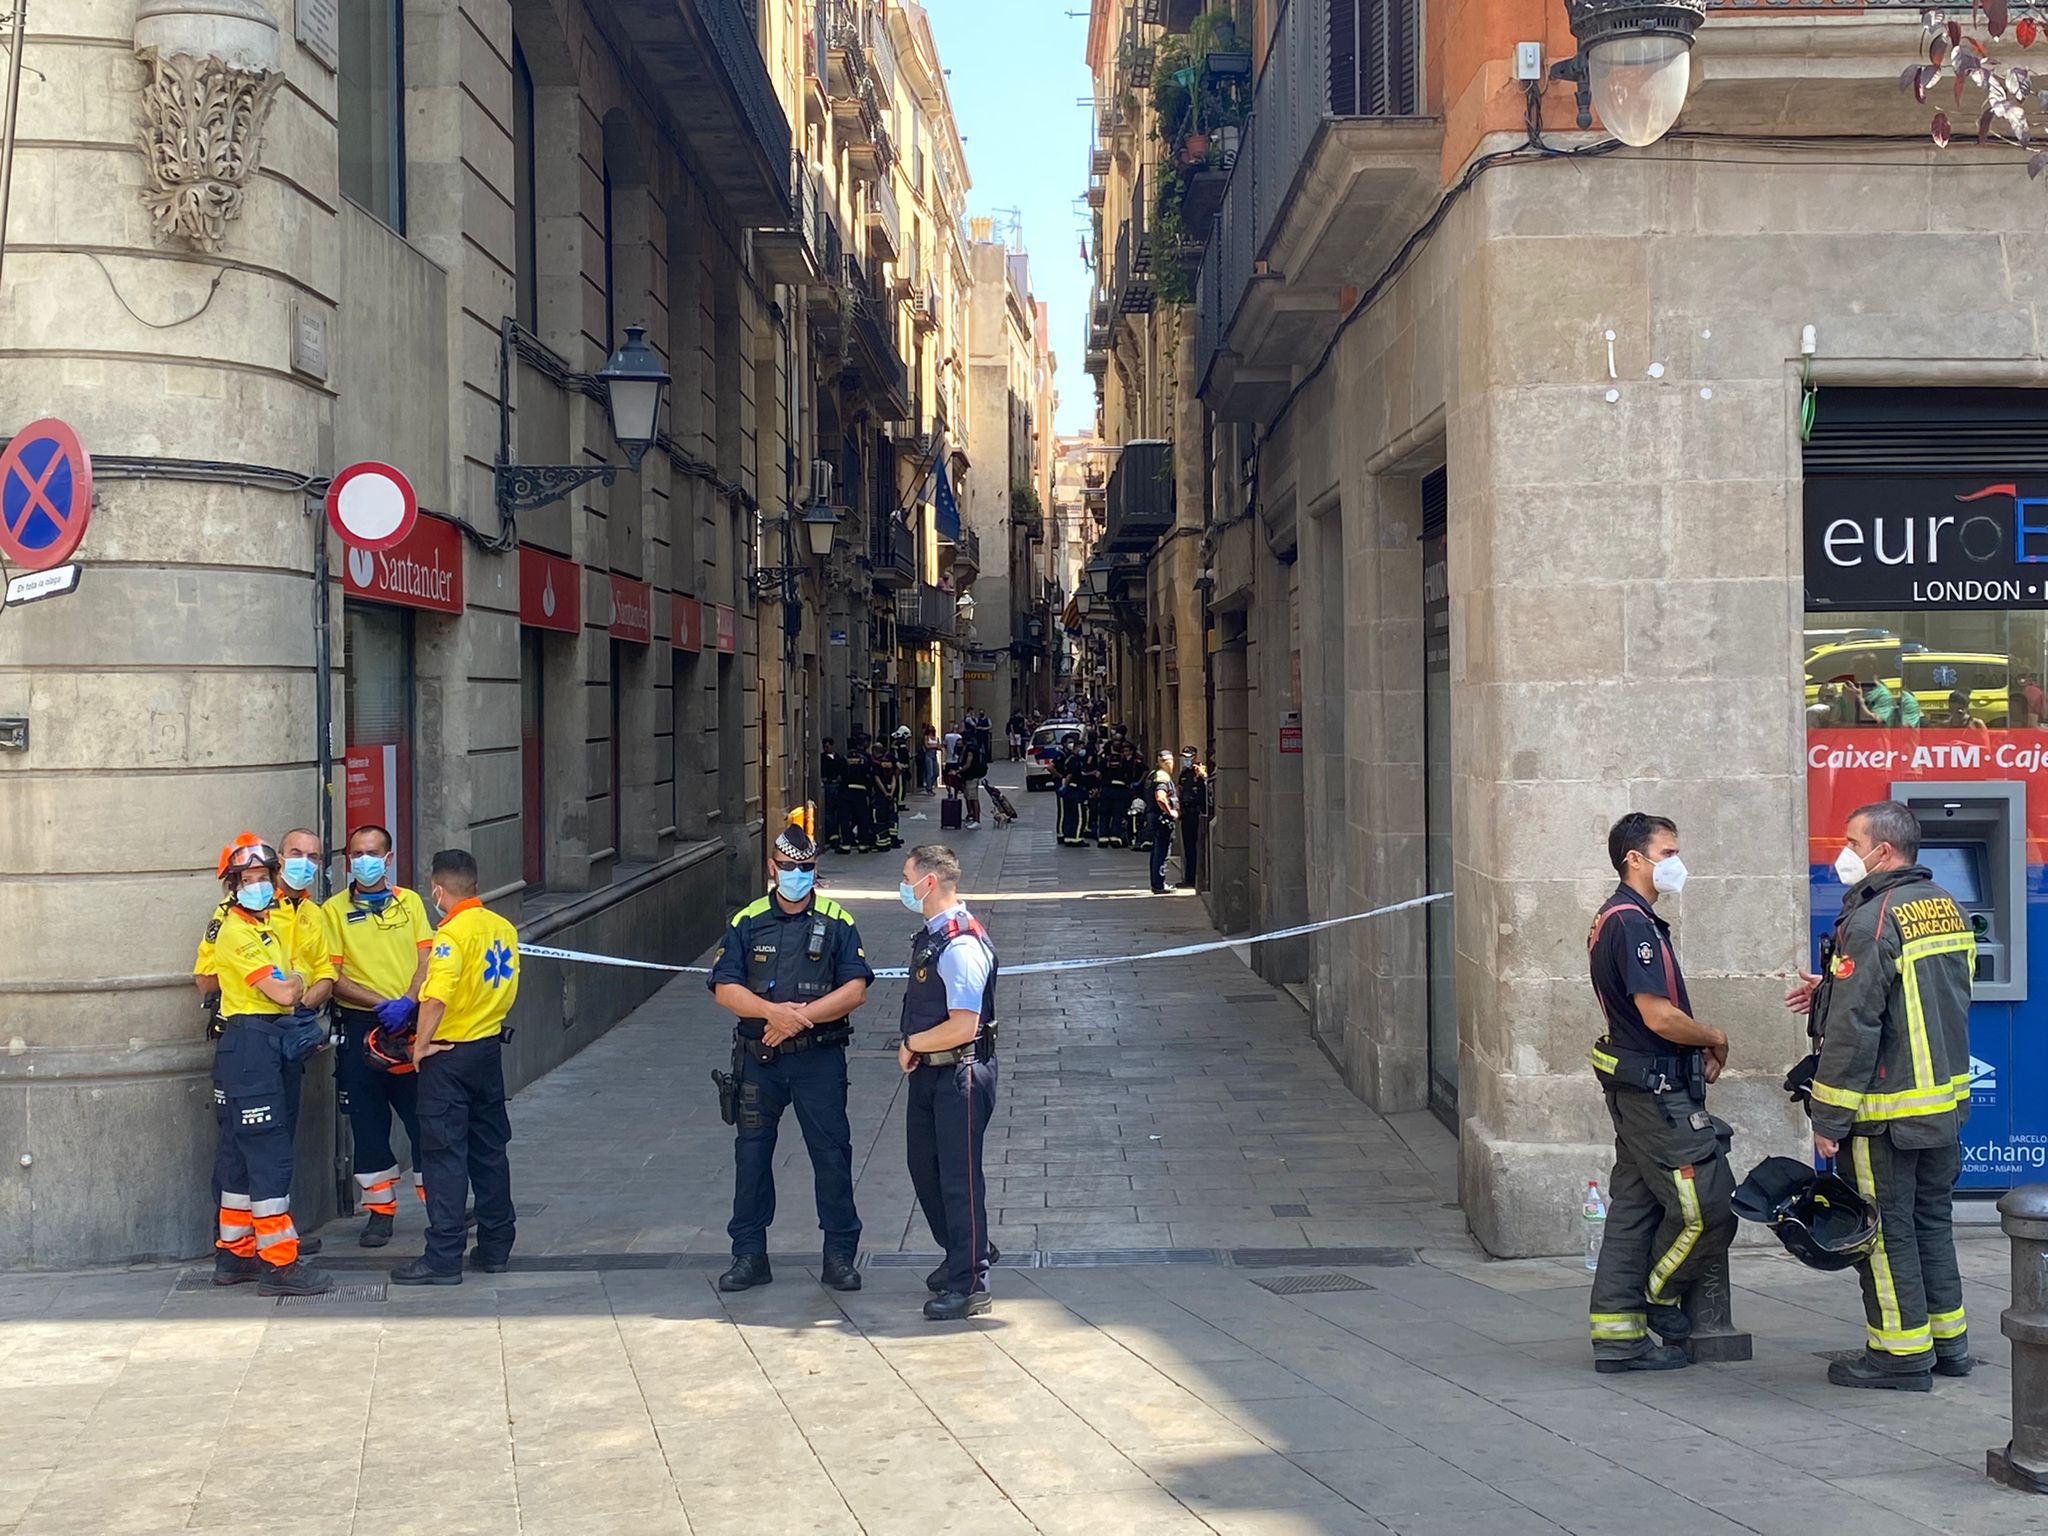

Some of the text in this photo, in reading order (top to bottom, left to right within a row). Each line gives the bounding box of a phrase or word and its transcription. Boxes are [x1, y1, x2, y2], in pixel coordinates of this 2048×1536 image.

[379, 547, 453, 602] Santander
[1913, 580, 2020, 601] LONDON
[1808, 744, 1898, 768] Caixer
[1910, 745, 1980, 768] ATM
[1902, 917, 1966, 940] BARCELONA
[1960, 1140, 2046, 1168] xchang
[1961, 1165, 2023, 1173] ADRID MIAMI
